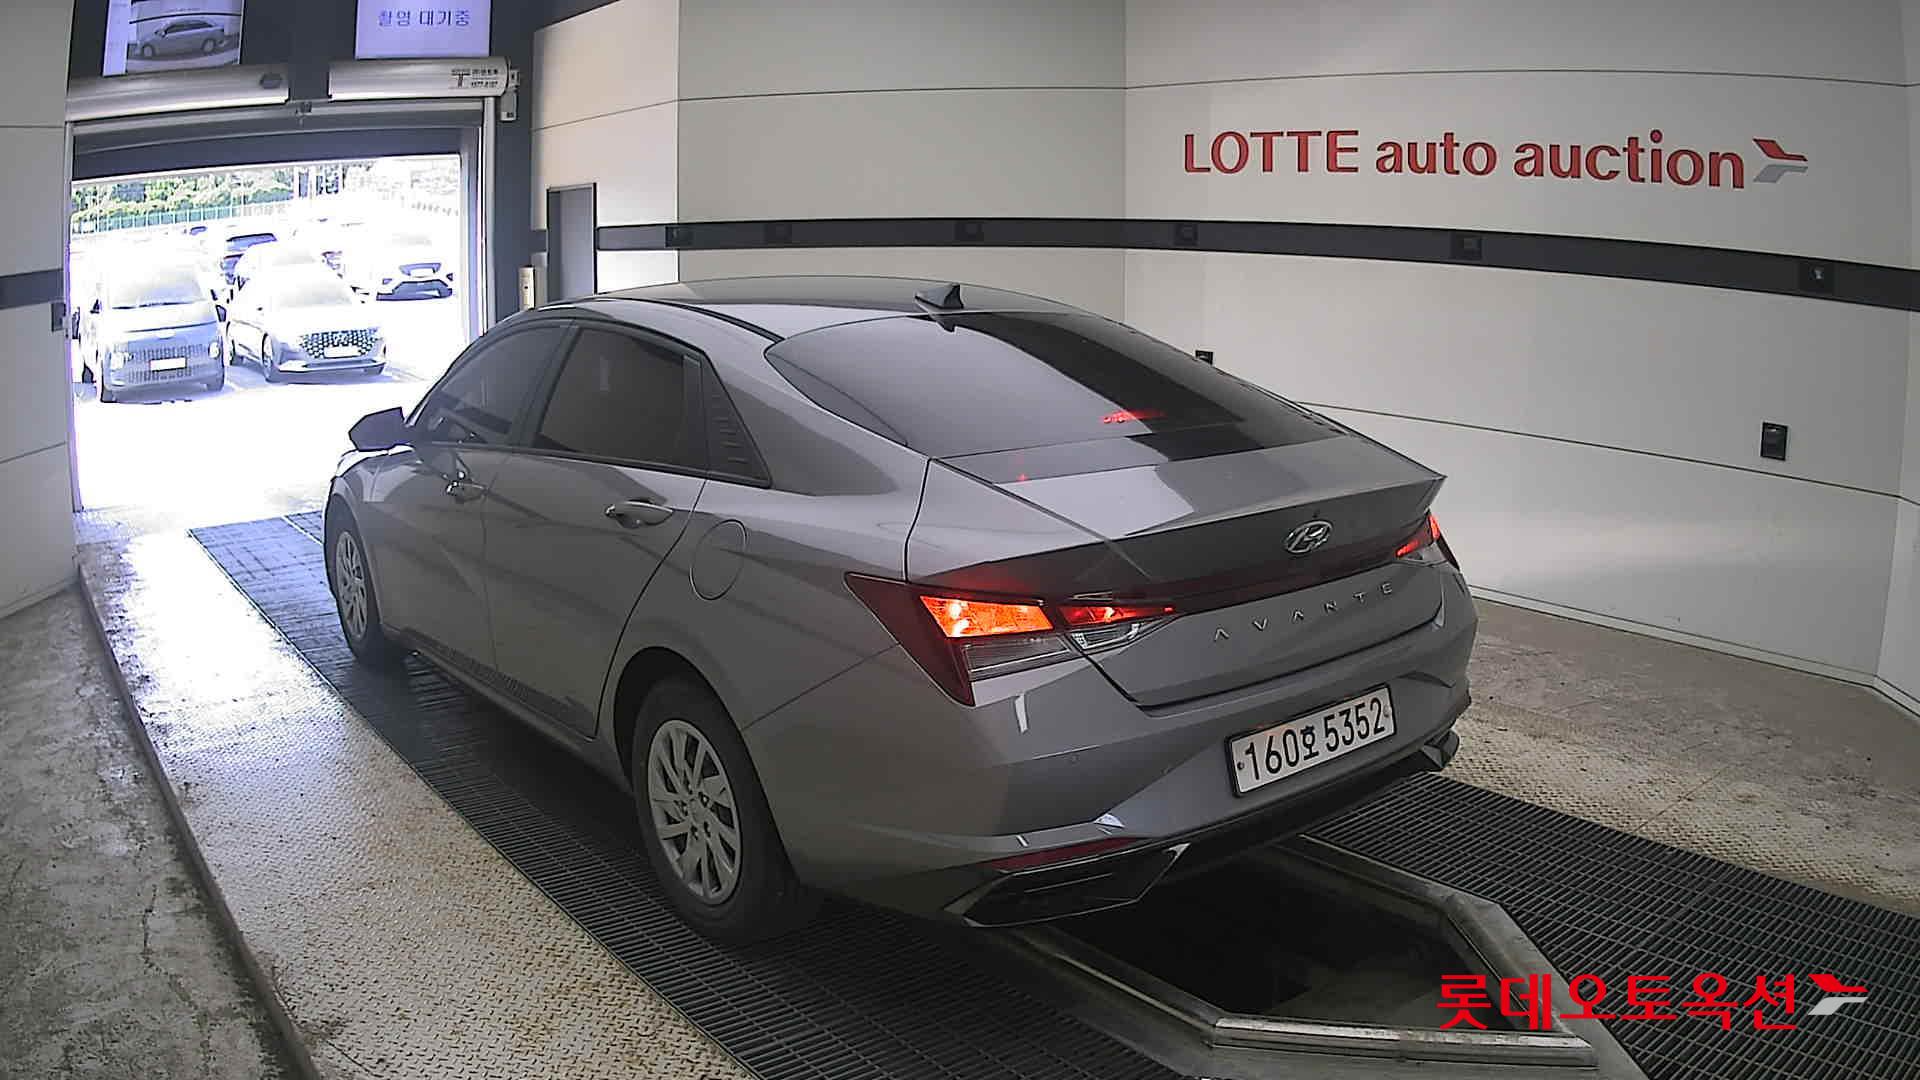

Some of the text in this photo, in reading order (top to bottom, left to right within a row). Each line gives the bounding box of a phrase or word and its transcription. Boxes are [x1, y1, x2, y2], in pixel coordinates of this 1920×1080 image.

[419, 9, 471, 26] 대기중
[1184, 129, 1745, 189] LOTTE auto auction
[1213, 583, 1393, 642] AVANTE
[1245, 697, 1385, 781] 160호 5352
